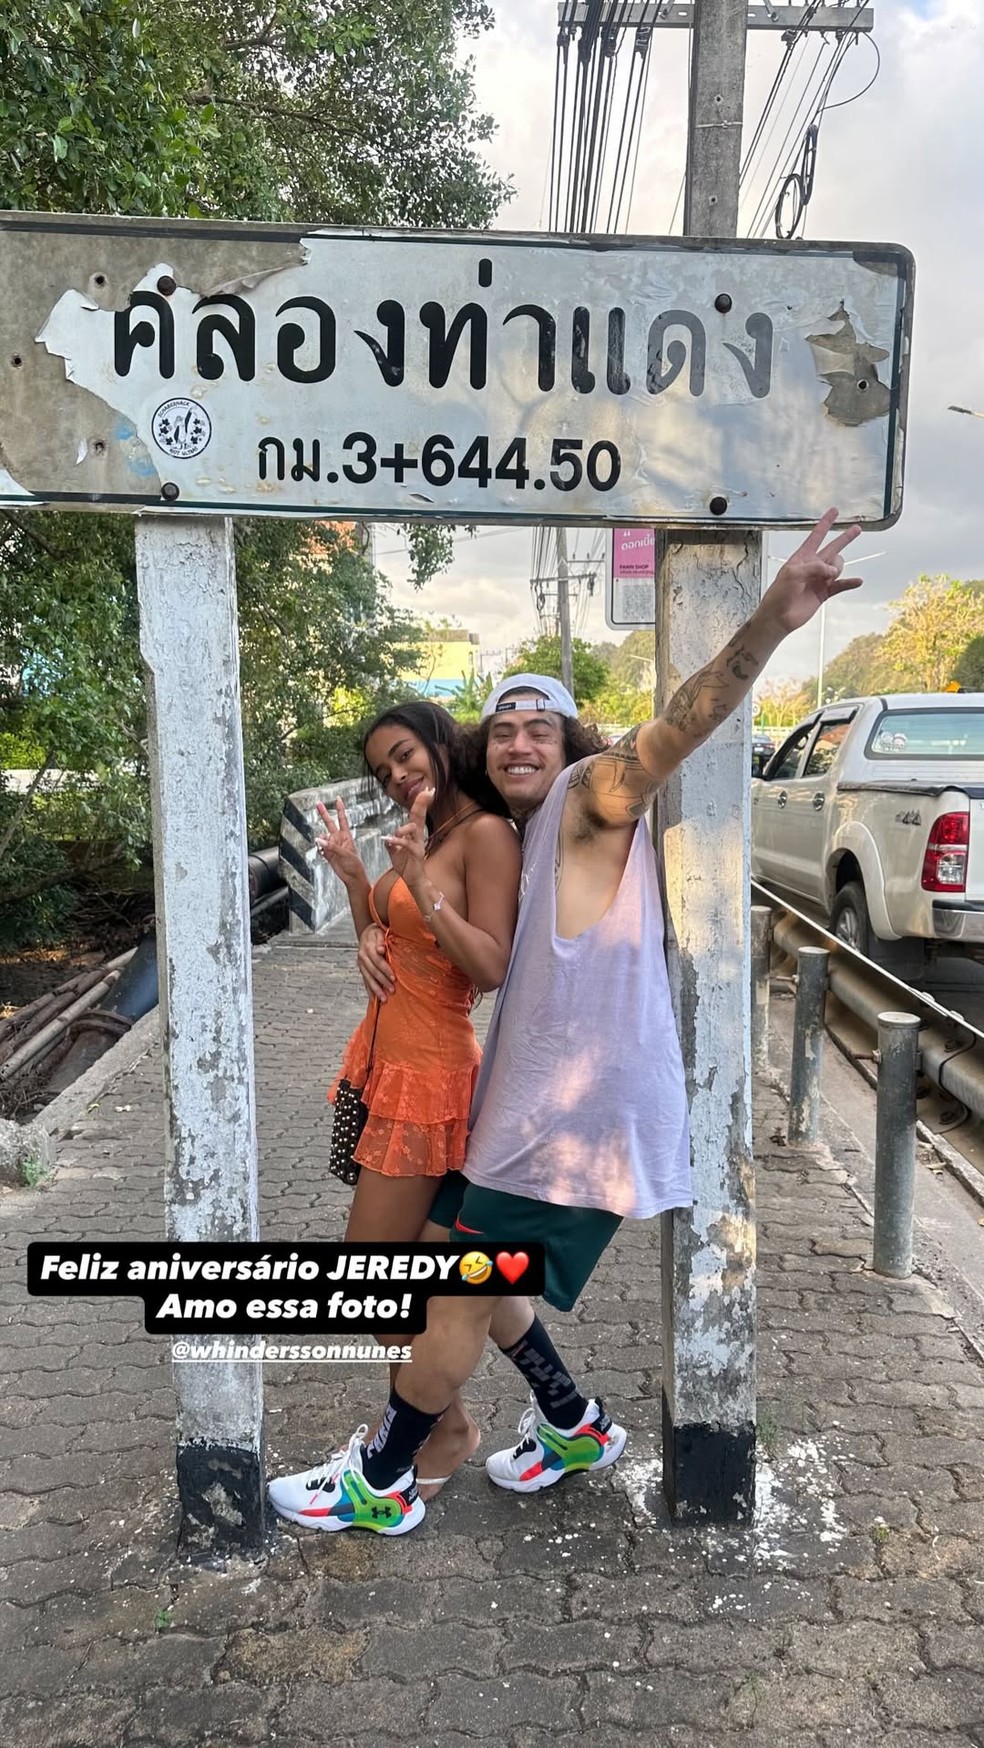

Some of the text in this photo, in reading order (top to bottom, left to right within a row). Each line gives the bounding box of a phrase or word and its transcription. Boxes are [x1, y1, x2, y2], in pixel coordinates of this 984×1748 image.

[114, 258, 772, 398] คลองท่าแดง
[258, 432, 621, 491] กม.3+644.50
